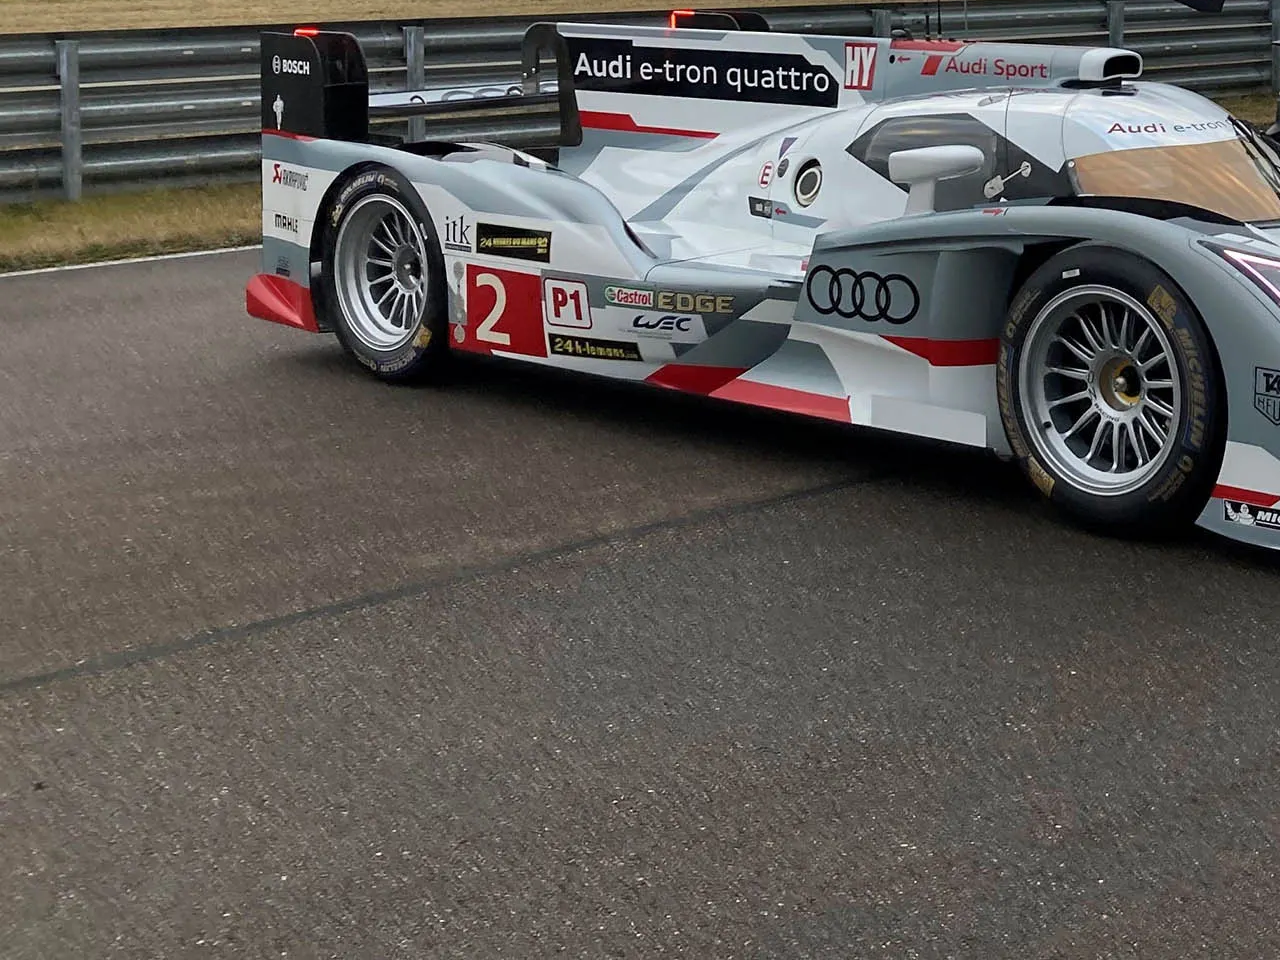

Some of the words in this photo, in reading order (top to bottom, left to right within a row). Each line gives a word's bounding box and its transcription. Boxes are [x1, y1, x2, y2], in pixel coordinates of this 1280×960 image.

[282, 58, 310, 75] BOSCH
[574, 52, 631, 79] Audi
[640, 59, 717, 85] e-tron
[726, 67, 830, 93] quattro
[845, 45, 876, 87] HY
[945, 57, 987, 74] Audi
[993, 58, 1048, 80] Sport
[1108, 123, 1167, 134] Audi
[1173, 119, 1224, 133] e-tron
[761, 165, 772, 185] E
[274, 213, 299, 234] MAHLE
[444, 215, 472, 245] itk
[476, 272, 511, 346] 2
[552, 286, 583, 321] P1
[616, 288, 652, 305] Castrol
[657, 291, 735, 314] EDGE
[632, 314, 692, 332] WEC
